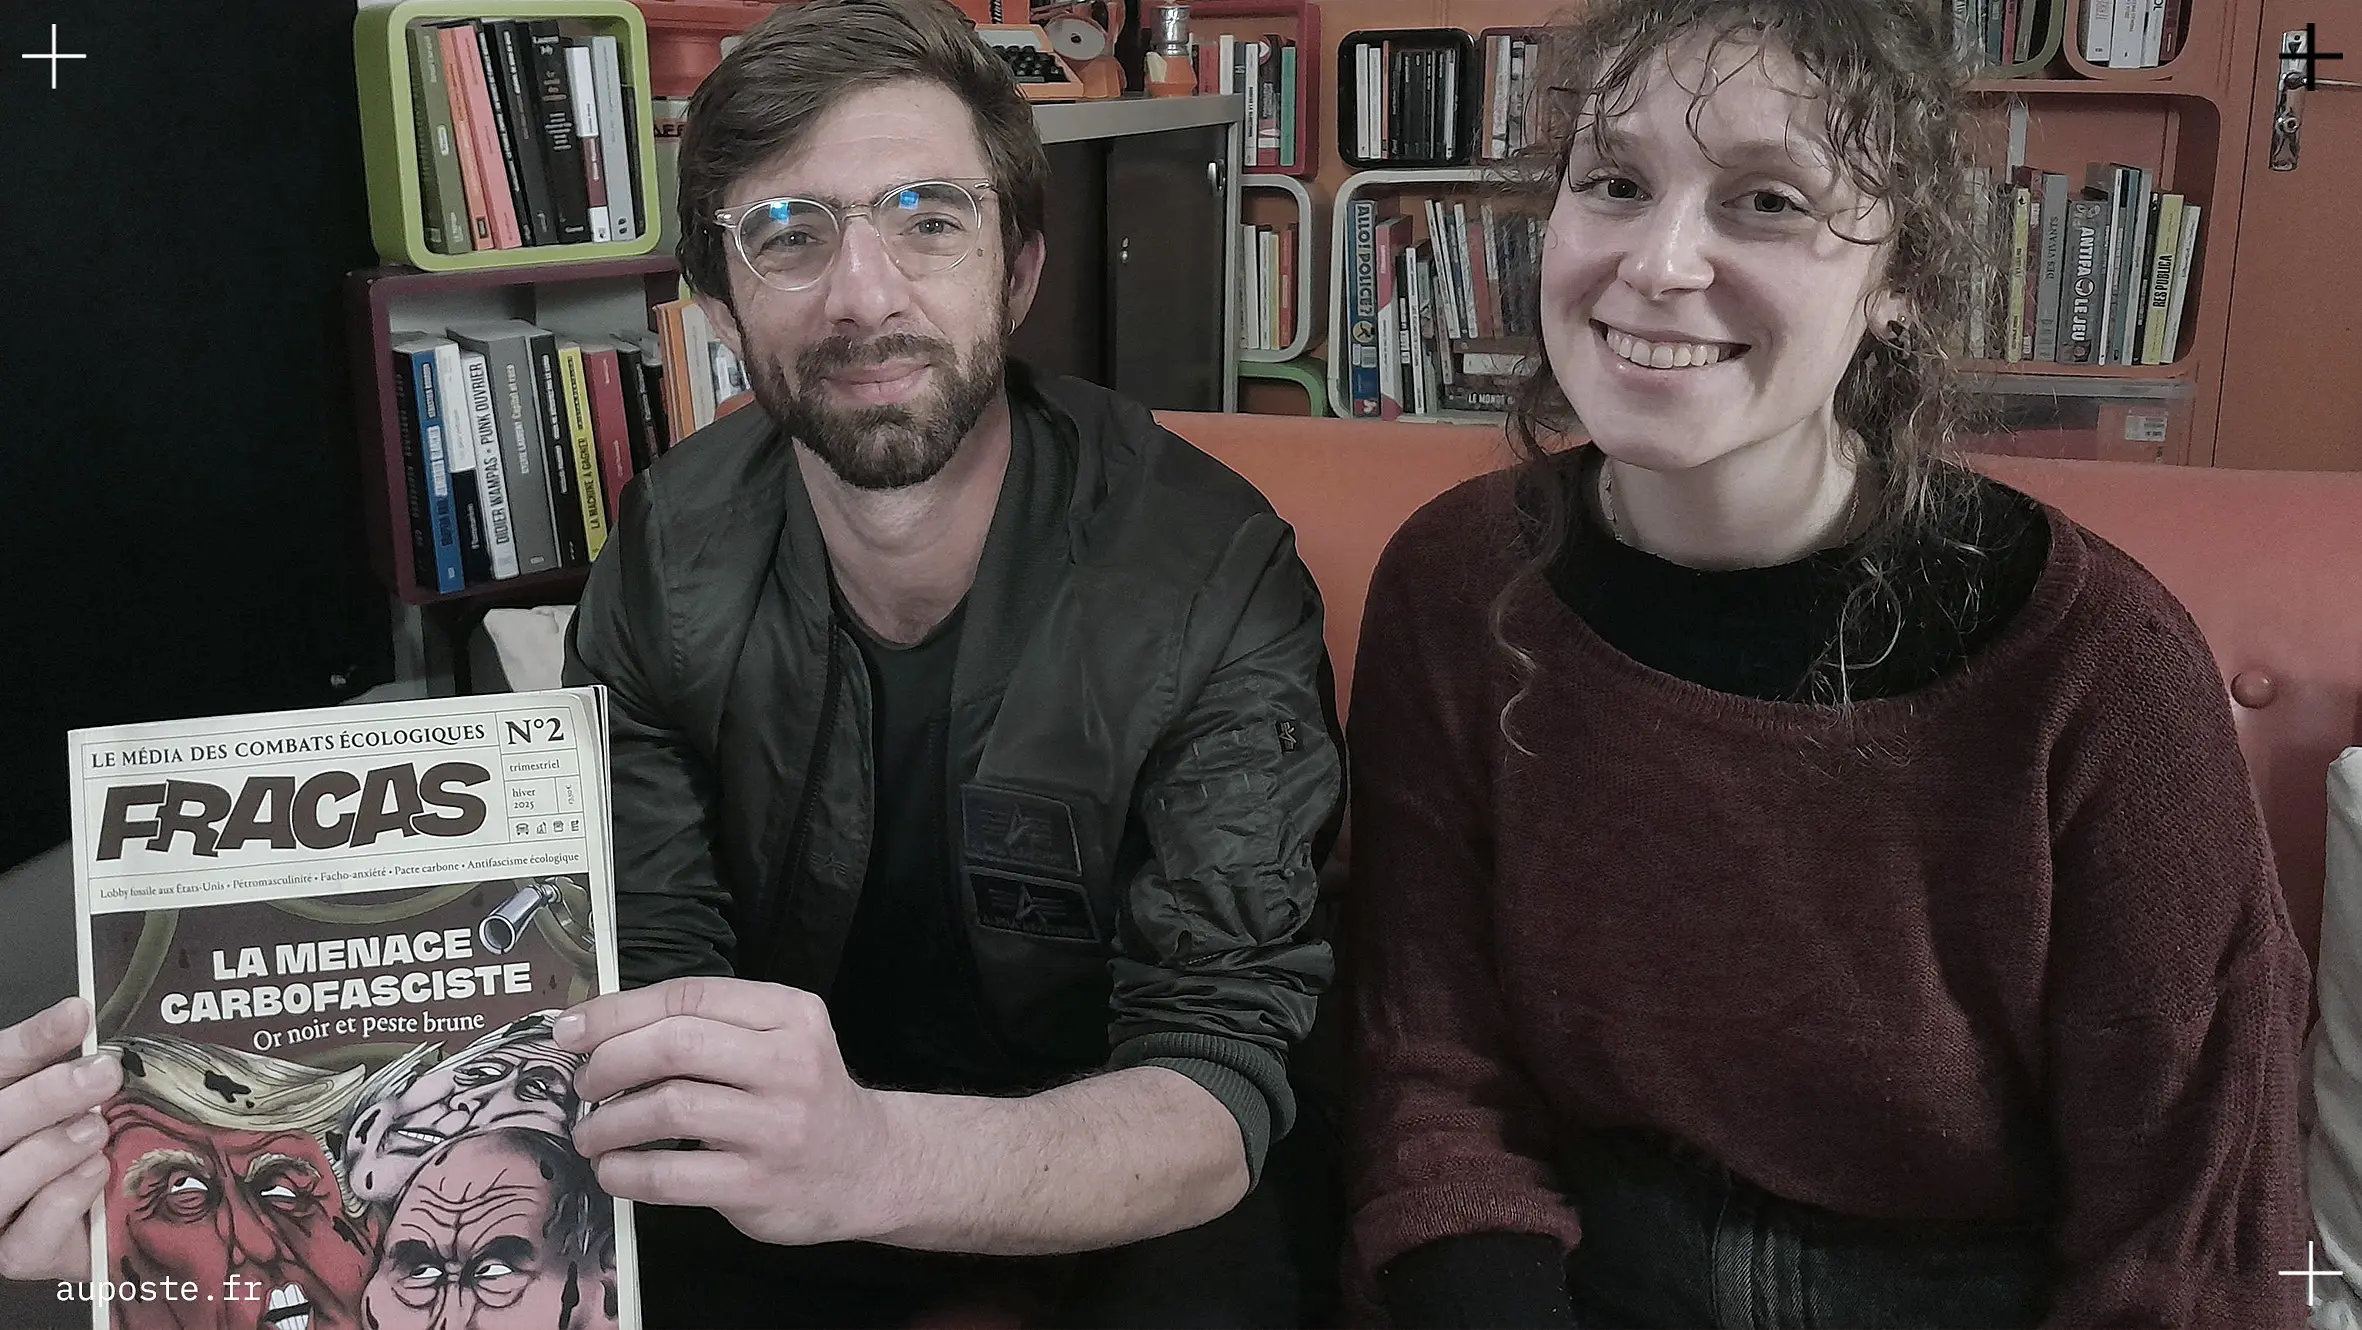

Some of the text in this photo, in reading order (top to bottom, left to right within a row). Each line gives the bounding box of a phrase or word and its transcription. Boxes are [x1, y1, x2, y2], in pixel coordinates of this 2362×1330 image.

[1357, 205, 1371, 251] ALLO!
[2048, 216, 2059, 260] VIVANTS
[2071, 226, 2095, 342] ANTIFA LE JEU
[2152, 255, 2173, 308] RES PUBLICA
[469, 362, 510, 545] DIDIER WAMPAS PUNK OUVRIER
[92, 723, 486, 768] LE MÉDIA DES COMBATS ÉCOLOGIQUES
[504, 717, 565, 745] N°2
[510, 759, 560, 772] trimestriel
[96, 761, 491, 862] FRACAS
[512, 788, 536, 798] hiver
[513, 800, 535, 810] 2025
[100, 852, 580, 901] Lobby fossile aux États-Unis Pétromasculinité Facho-anxiété Pacte carbone Antifascisme écologique
[212, 927, 473, 981] LA MENACE
[160, 962, 532, 1024] CARBOFASCISTE
[253, 1010, 485, 1051] Or noir et peste brune
